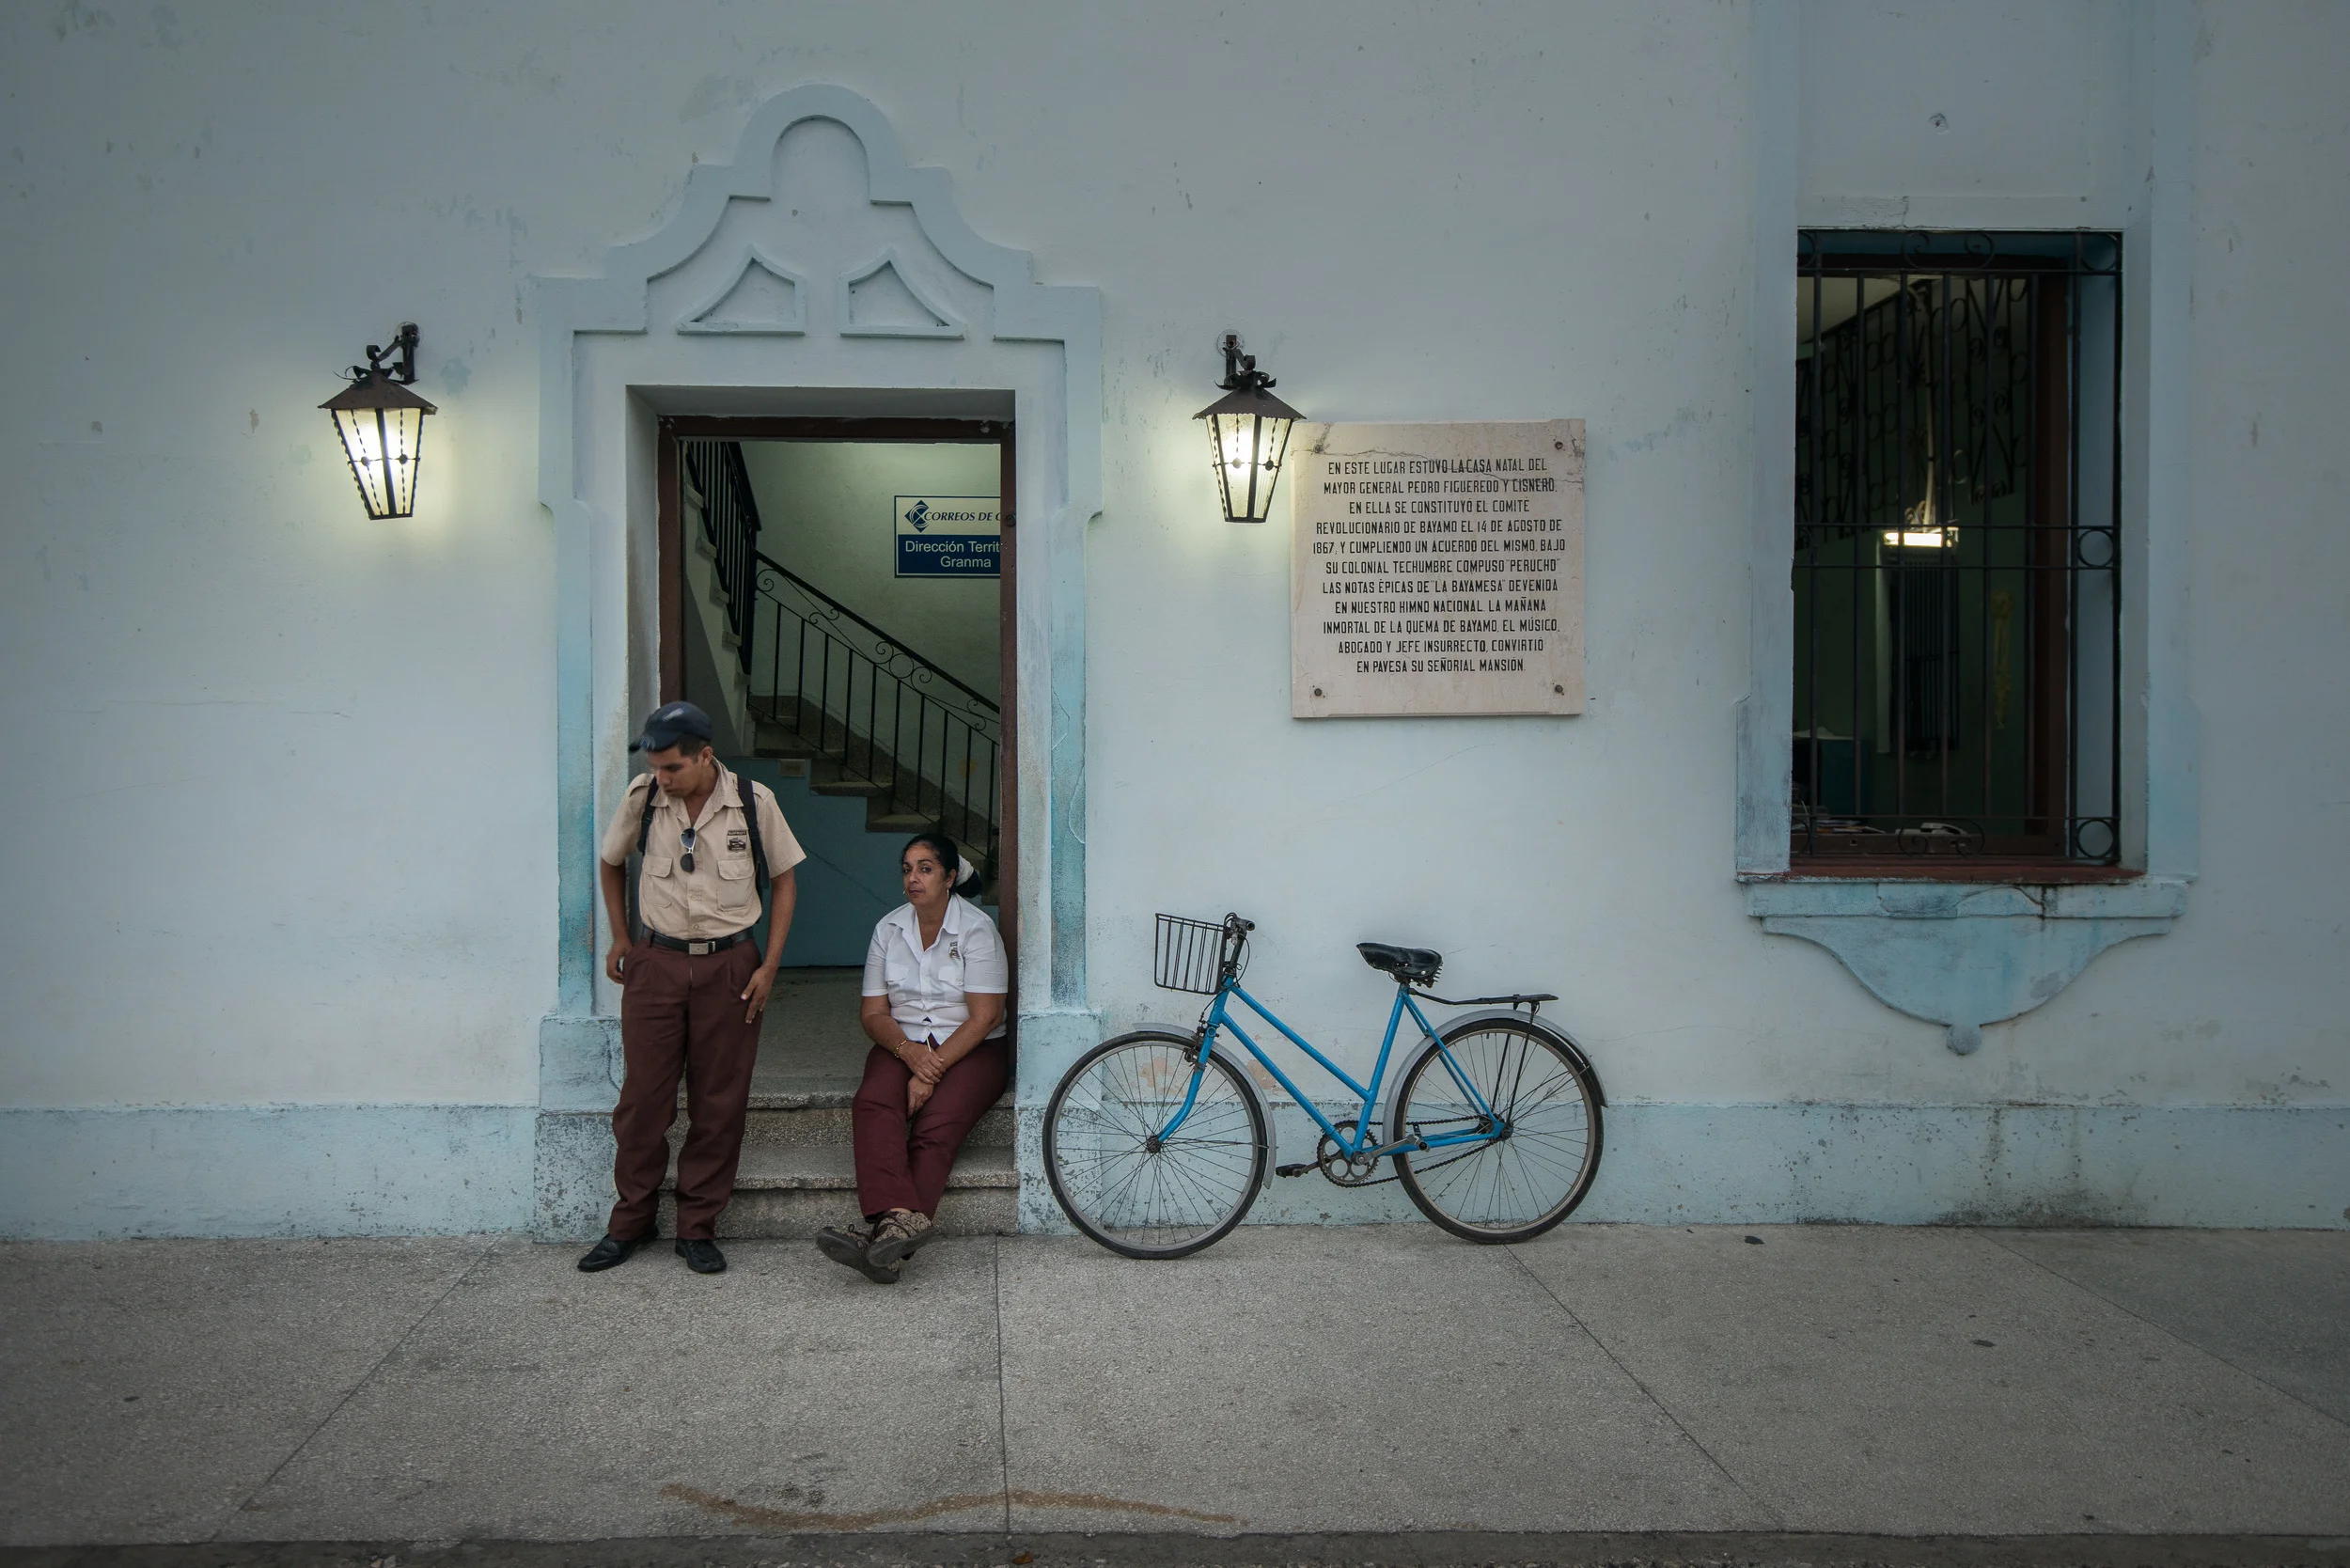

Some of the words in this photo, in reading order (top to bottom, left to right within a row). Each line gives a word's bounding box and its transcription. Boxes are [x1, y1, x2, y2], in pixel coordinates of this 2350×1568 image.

[1328, 462, 1341, 475] EN
[1344, 462, 1371, 474] ESTE
[1373, 461, 1405, 474] LUGAR
[1409, 460, 1448, 474] ESTUVO
[1451, 459, 1465, 474] LA
[1496, 458, 1525, 471] NATAL
[1528, 458, 1547, 471] DEL
[1324, 481, 1355, 494] MAYOR
[1359, 480, 1403, 494] GENERAL
[1407, 480, 1440, 494] PEDRO
[1444, 479, 1499, 494] FIGUEREDO
[1503, 478, 1509, 493] Y
[1349, 501, 1362, 514] EN
[1365, 501, 1391, 514] ELLA
[1394, 501, 1407, 514] SE
[1411, 497, 1473, 513] CONSTITUYÓ
[1476, 500, 1488, 513] EL
[1492, 496, 1530, 512] COMITÉ
[924, 511, 976, 522] CORREOS
[978, 511, 993, 522] DE
[1316, 521, 1400, 535] REVOLUCIONARIO
[1403, 521, 1417, 534] DE
[1419, 520, 1457, 533] BAYAMO
[1461, 520, 1474, 533] EL
[1477, 520, 1487, 533] 14
[1491, 520, 1503, 532] DE
[1507, 519, 1546, 532] AGOSTO
[1549, 519, 1562, 532] DE
[905, 541, 964, 553] Dirección
[1340, 541, 1346, 554] Y
[1349, 541, 1412, 554] CUMPLIENDO
[1415, 541, 1428, 553] UN
[1432, 540, 1478, 553] ACUERDO
[1480, 540, 1499, 552] DEL
[1504, 539, 1538, 552] MISMO,
[1540, 539, 1566, 551] BAJO
[940, 556, 992, 568] Granma
[1325, 561, 1339, 574] SU
[1341, 561, 1389, 574] COLONIAL
[1392, 560, 1452, 572] TECHUMBRE
[1456, 559, 1505, 572] COMPUSO
[1323, 582, 1341, 594] LAS
[1344, 581, 1375, 593] NOTAS
[1378, 578, 1414, 593] ÉPICAS
[1417, 580, 1430, 593] DE
[1509, 579, 1559, 592] DEVENIDA
[1335, 601, 1348, 614] EN
[1351, 601, 1396, 614] NUESTRO
[1399, 601, 1430, 613] HIMNO
[1488, 600, 1501, 612] LA
[1505, 596, 1546, 612] MAÑANA
[1324, 620, 1371, 634] INMORTAL
[1373, 620, 1386, 634] DE
[1389, 620, 1402, 633] LA
[1405, 619, 1439, 635] QUEMA
[1443, 619, 1456, 633] DE
[1460, 619, 1499, 633] BAYAMO,
[1502, 619, 1515, 632] EL
[1519, 617, 1560, 633] MÚSICO,
[1338, 640, 1383, 653] ABOGADO
[1386, 640, 1392, 653] Y
[1395, 640, 1420, 653] JEFE
[1423, 639, 1489, 653] INSURRECTO,
[1491, 636, 1543, 651] CONVIRTIÓ
[1356, 660, 1370, 673] EN
[1372, 660, 1408, 672] PAVESA
[1411, 660, 1424, 672] SU
[1427, 657, 1476, 672] SEÑORIAL
